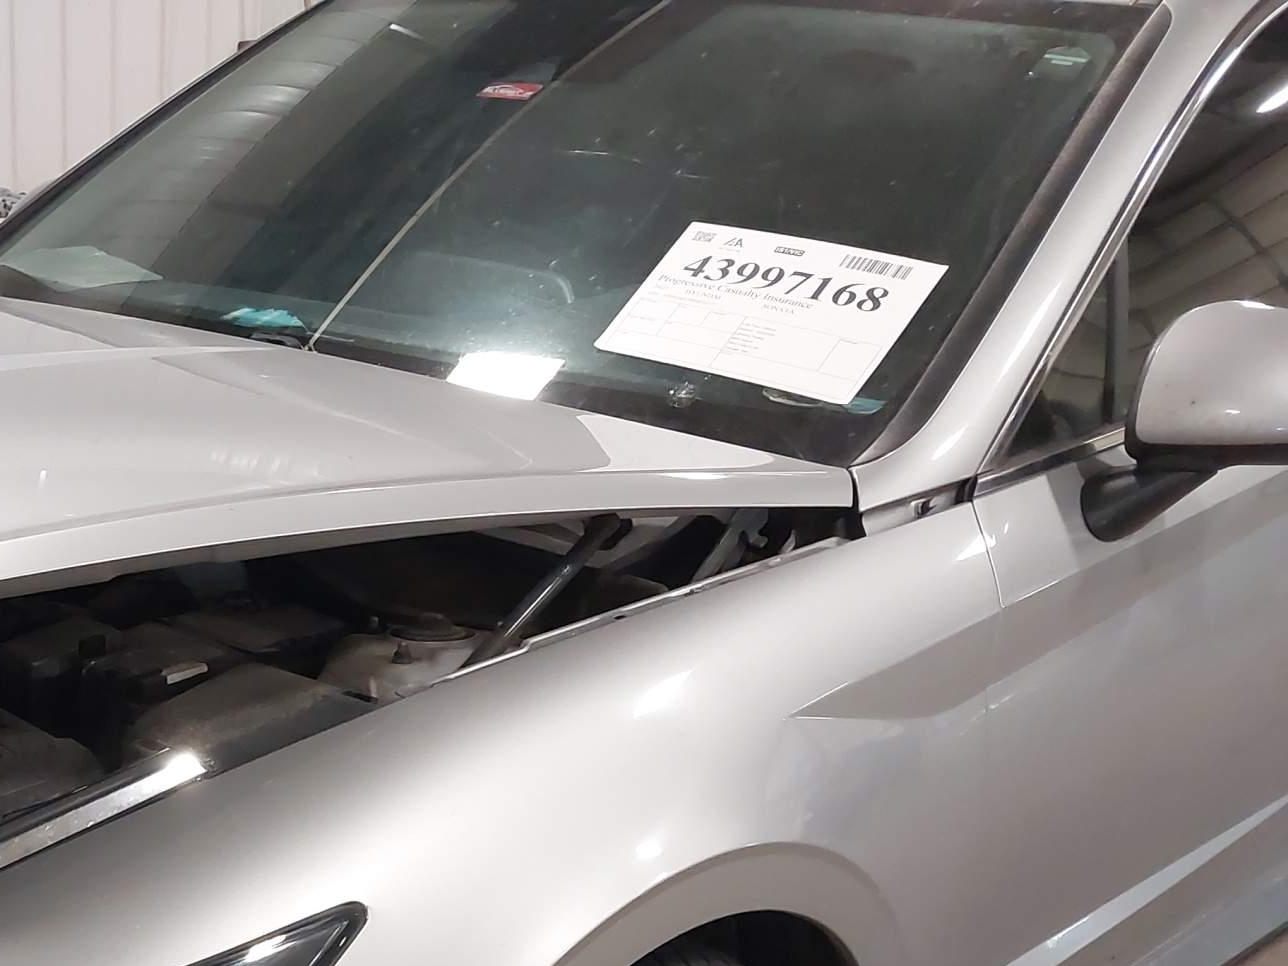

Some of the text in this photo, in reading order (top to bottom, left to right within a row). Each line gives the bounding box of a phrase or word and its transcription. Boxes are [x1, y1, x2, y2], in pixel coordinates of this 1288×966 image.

[658, 273, 715, 291] Progressive
[716, 284, 762, 299] Casualty
[762, 292, 814, 310] Insurance
[683, 255, 890, 312] 43997168
